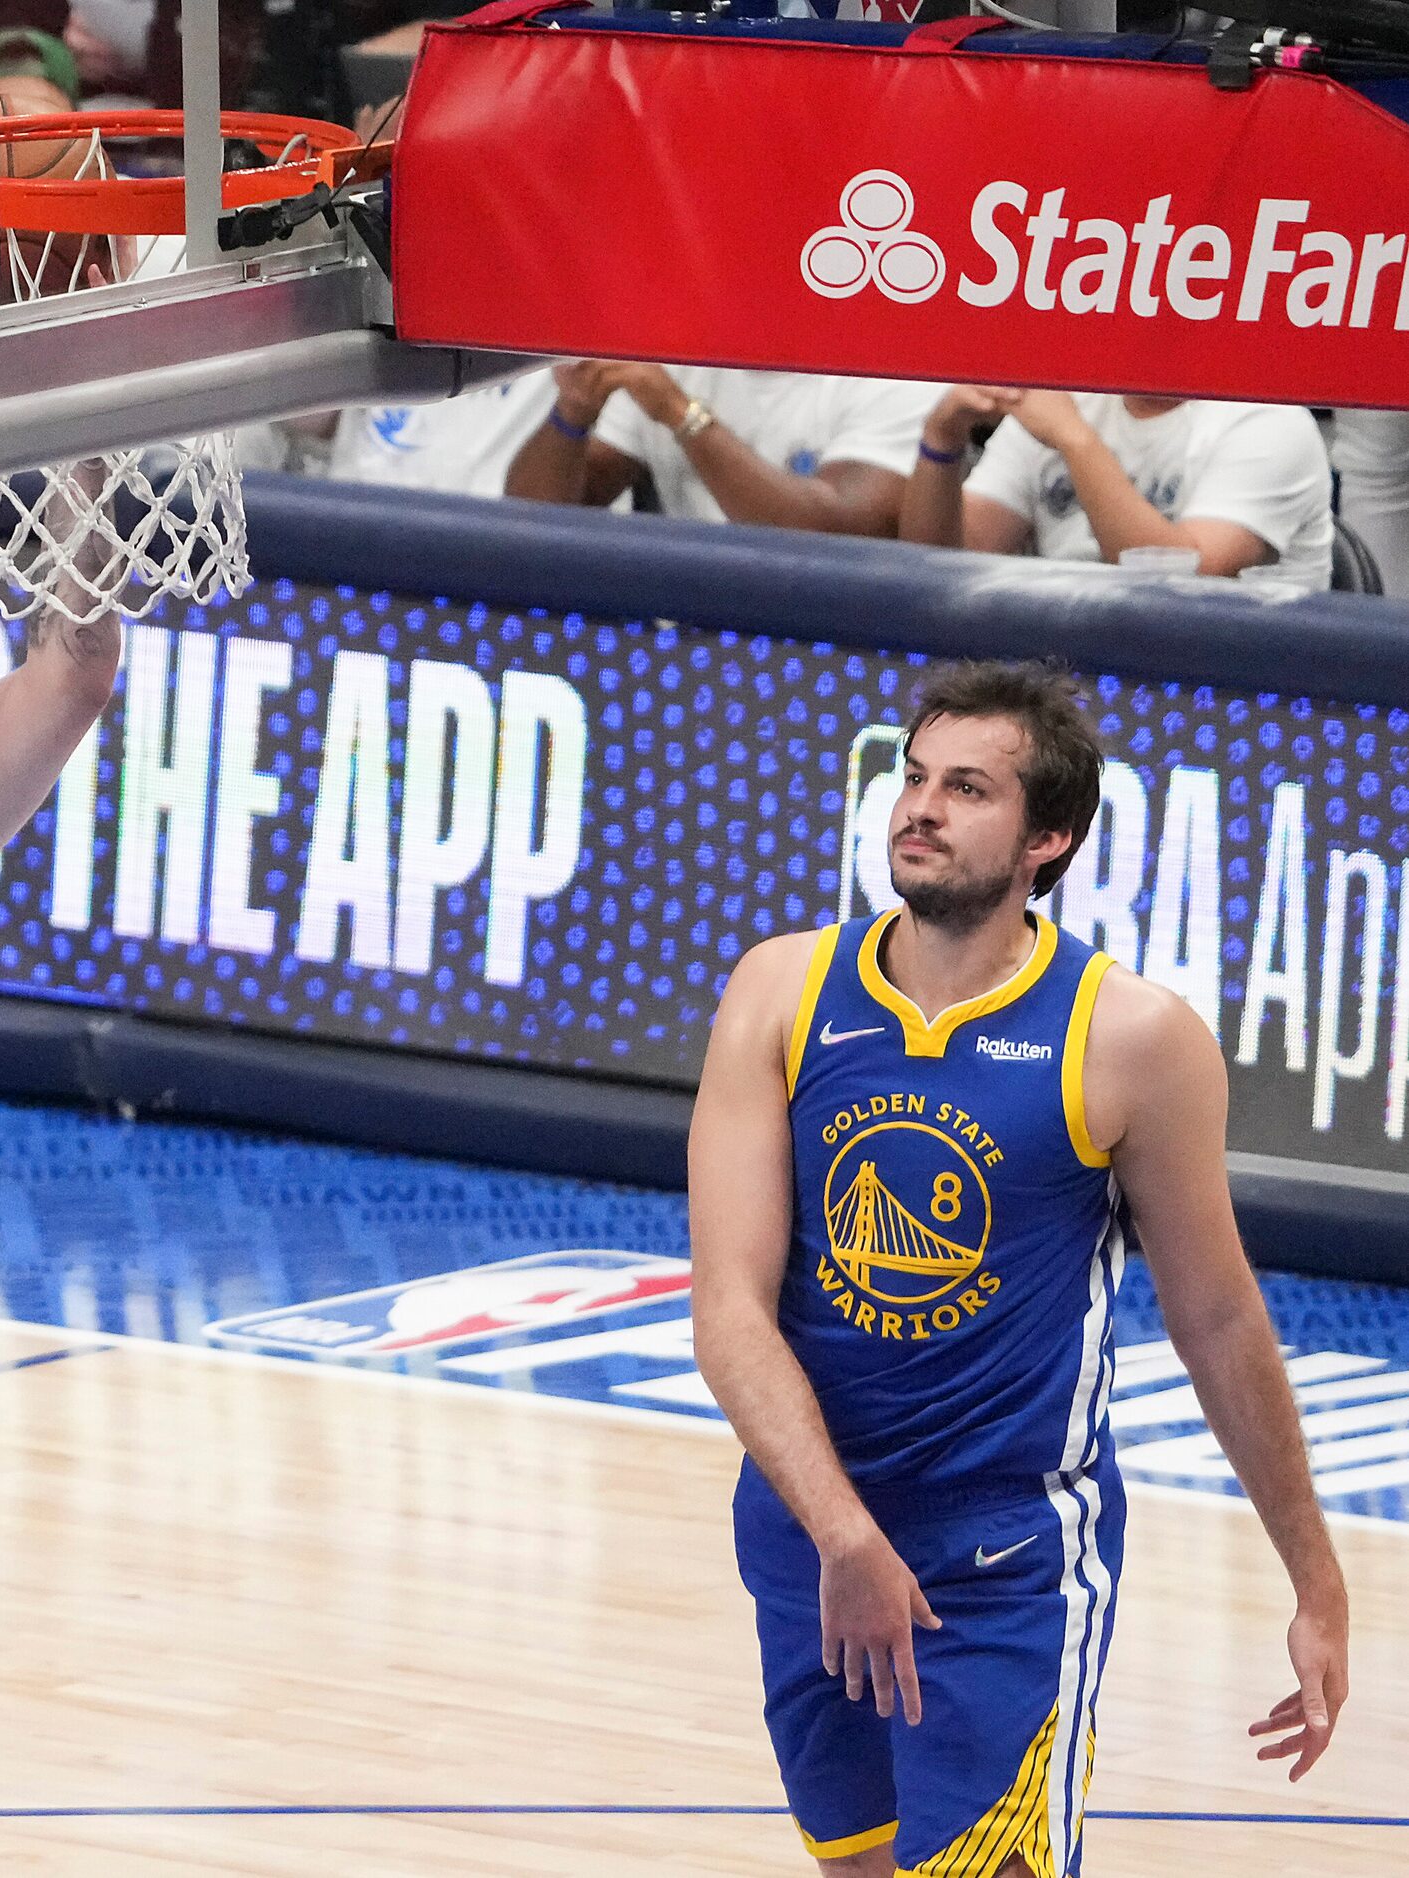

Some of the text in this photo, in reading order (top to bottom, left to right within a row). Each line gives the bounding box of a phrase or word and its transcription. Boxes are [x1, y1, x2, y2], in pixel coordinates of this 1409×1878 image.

[957, 180, 1409, 331] State Far
[294, 649, 588, 989] APP
[1024, 757, 1222, 1046] BA
[975, 1035, 1053, 1061] Rakuten
[821, 1093, 1005, 1168] GOLDEN STATE
[930, 1171, 963, 1222] 8
[815, 1254, 1002, 1341] WARRIORS
